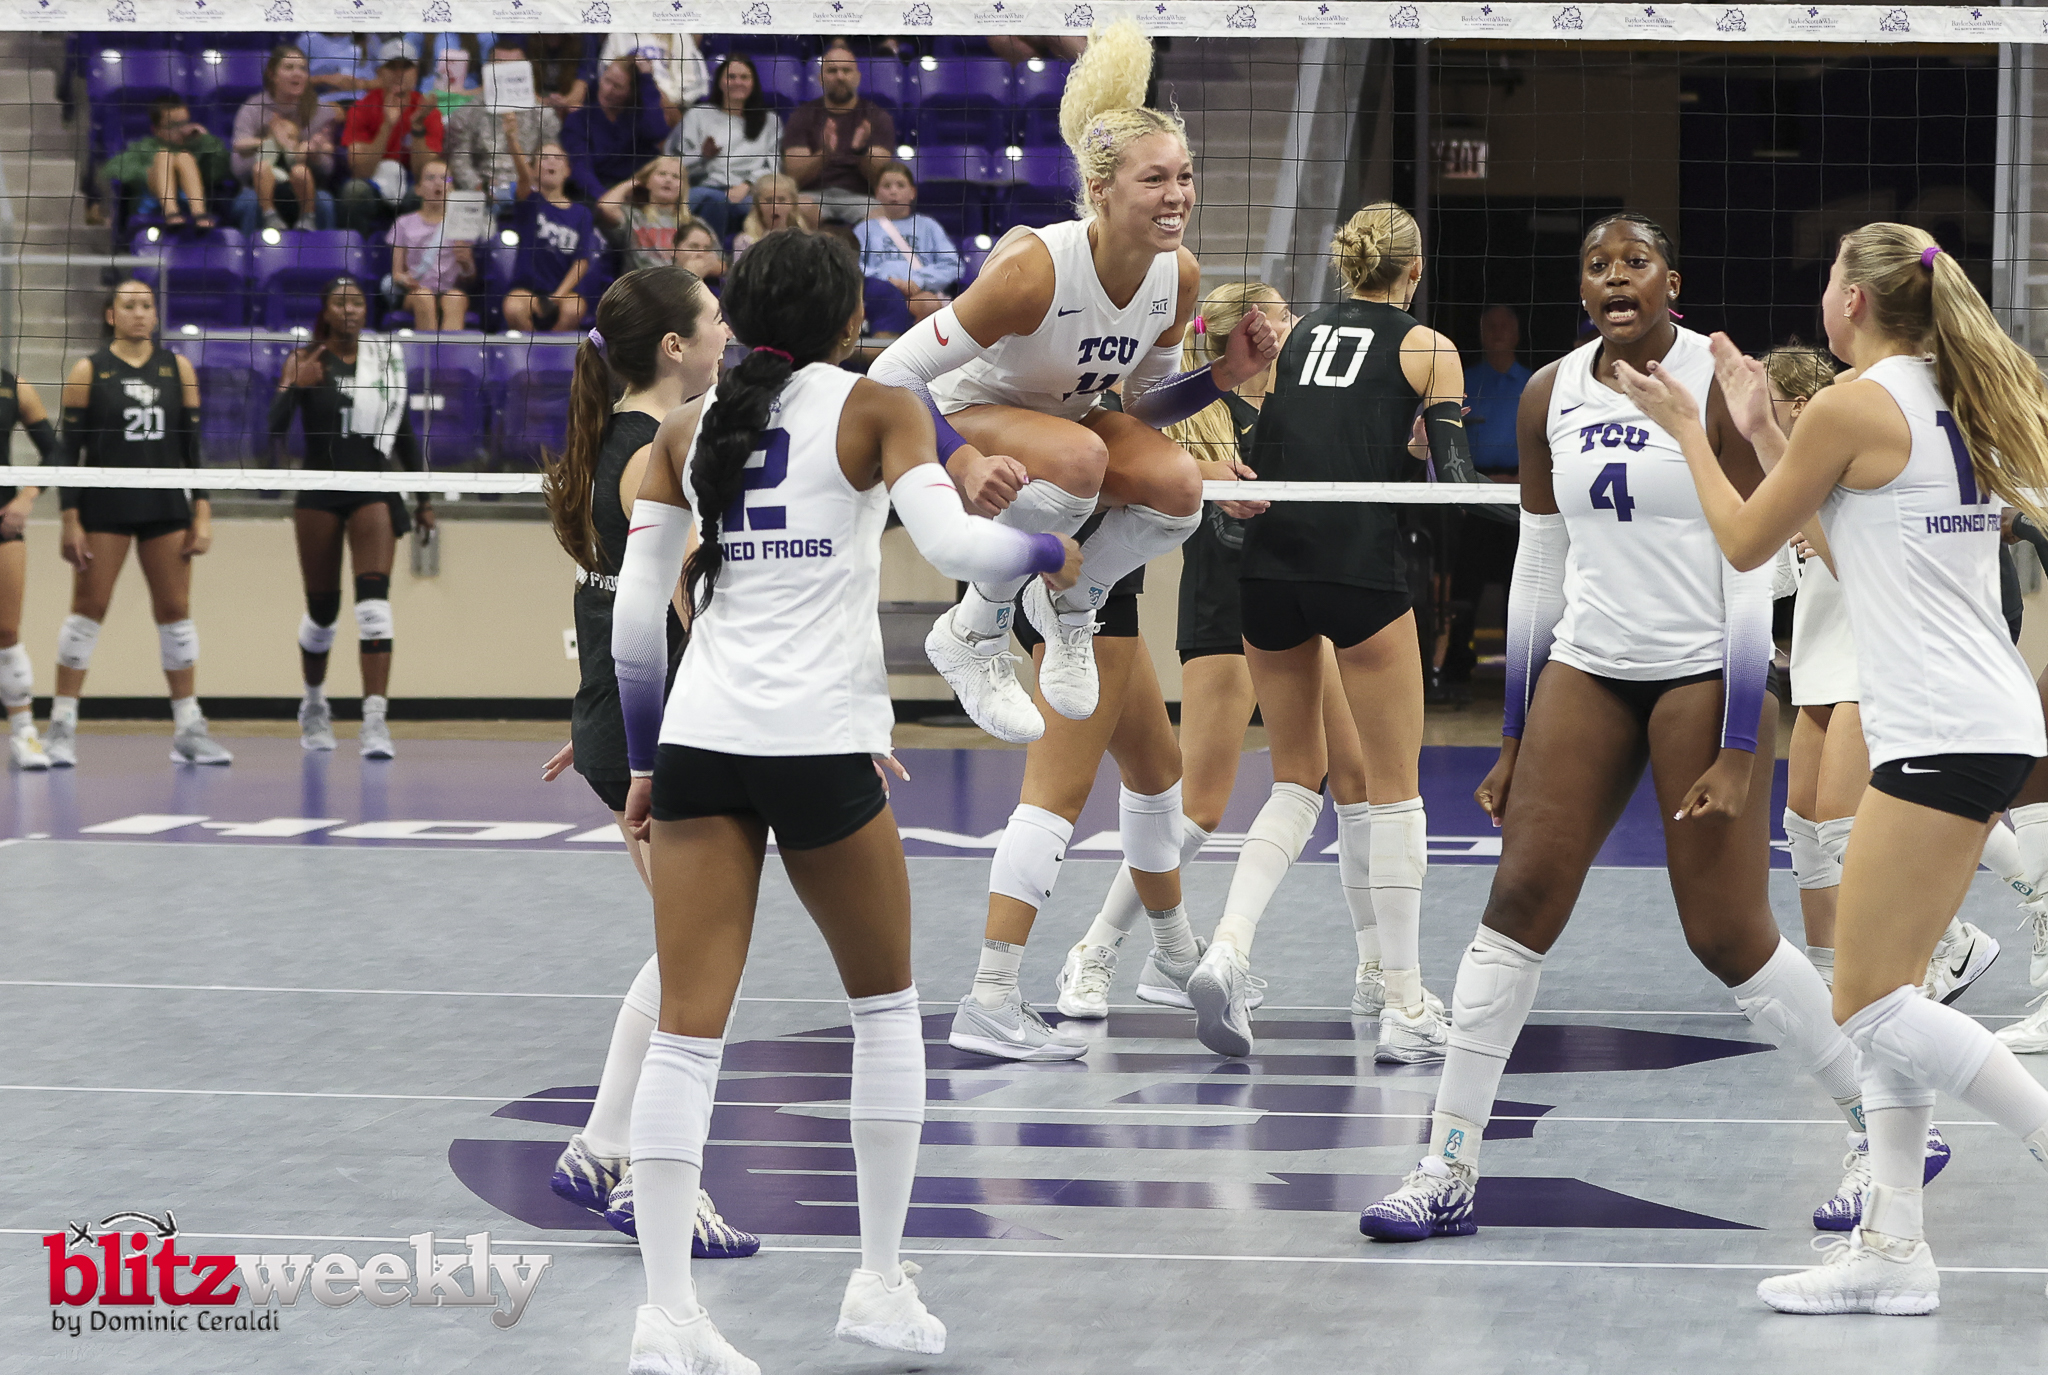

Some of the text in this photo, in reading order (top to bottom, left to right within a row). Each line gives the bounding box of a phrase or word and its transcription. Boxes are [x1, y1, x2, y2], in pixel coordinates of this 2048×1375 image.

[1077, 336, 1139, 366] TCU
[1299, 324, 1375, 388] 10
[122, 405, 165, 441] 20
[1580, 423, 1649, 454] TCU
[1936, 410, 1991, 505] 1
[722, 427, 790, 533] 2
[1589, 463, 1635, 522] 4
[1925, 514, 1985, 534] HORNED
[722, 538, 833, 562] NED FROGS
